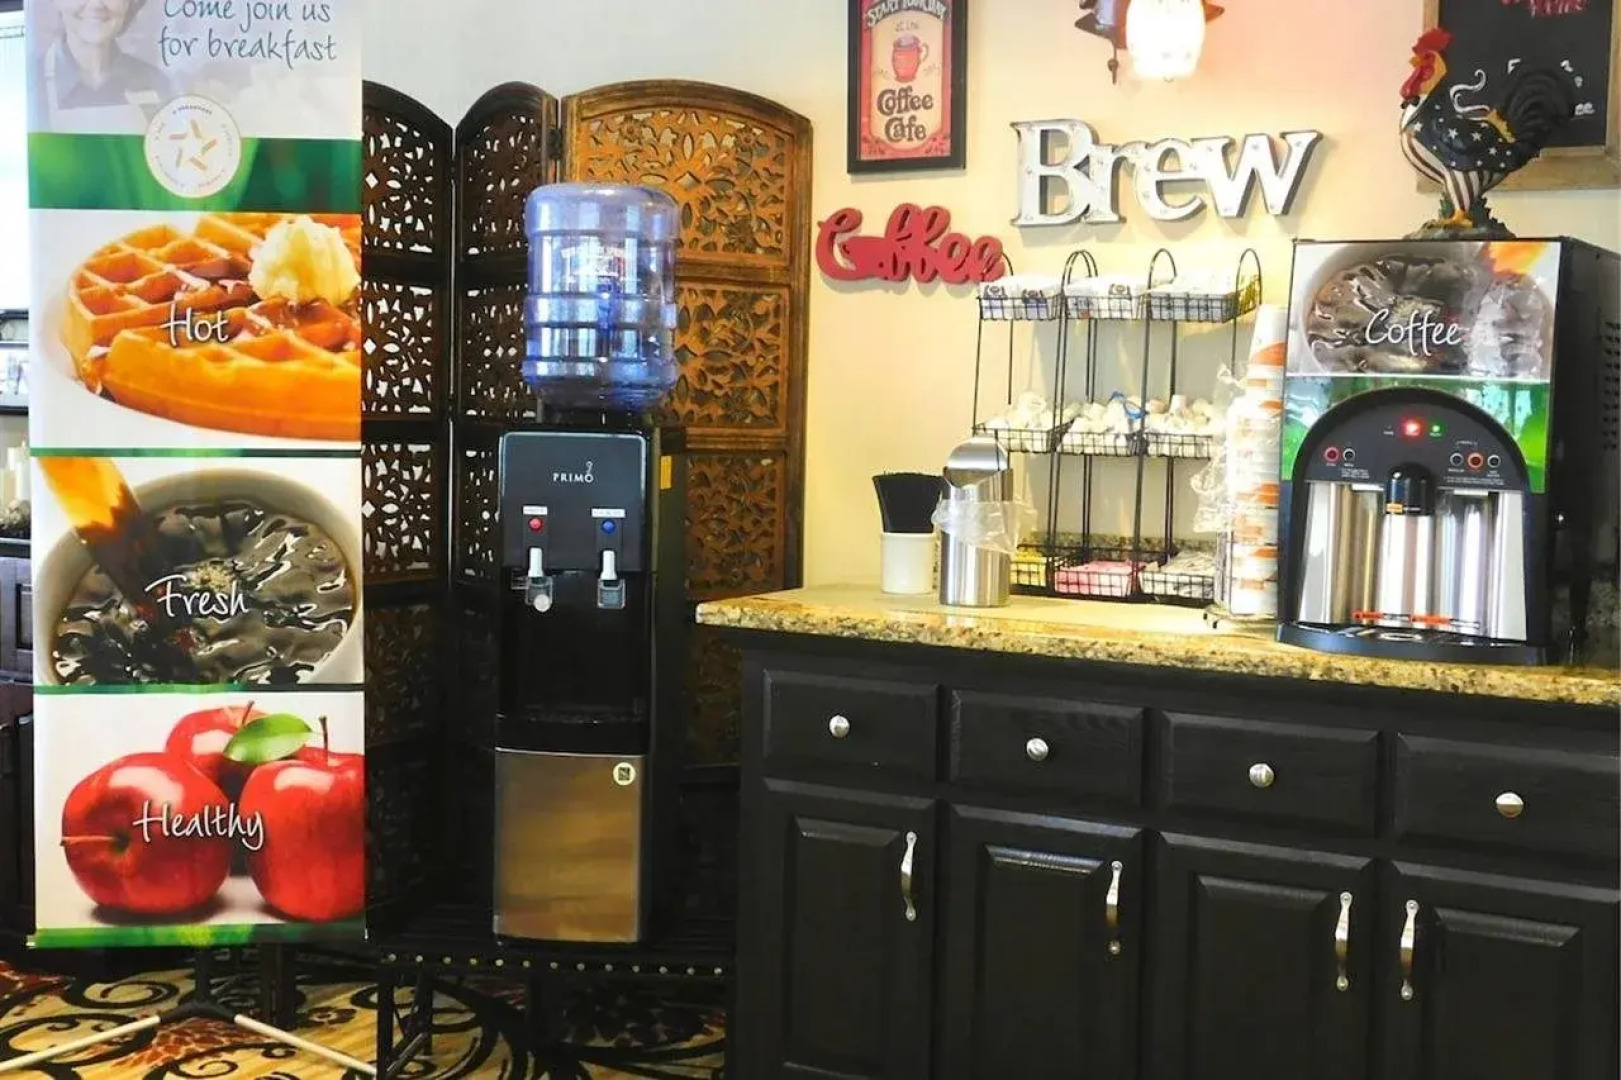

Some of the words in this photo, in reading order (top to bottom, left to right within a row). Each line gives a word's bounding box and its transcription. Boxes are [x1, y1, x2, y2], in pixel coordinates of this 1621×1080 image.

[164, 0, 235, 20] Come
[239, 0, 292, 33] join
[302, 3, 331, 22] us
[158, 25, 198, 66] for
[207, 27, 337, 70] breakfast
[877, 85, 934, 116] Coffee
[884, 115, 927, 143] Cafe
[1010, 118, 1323, 227] Brew
[816, 203, 1006, 285] Coffee
[160, 301, 229, 347] Hot
[1365, 308, 1470, 357] Coffee
[552, 464, 595, 484] PRIMO
[144, 574, 250, 617] Fresh
[132, 799, 264, 851] Healthy
